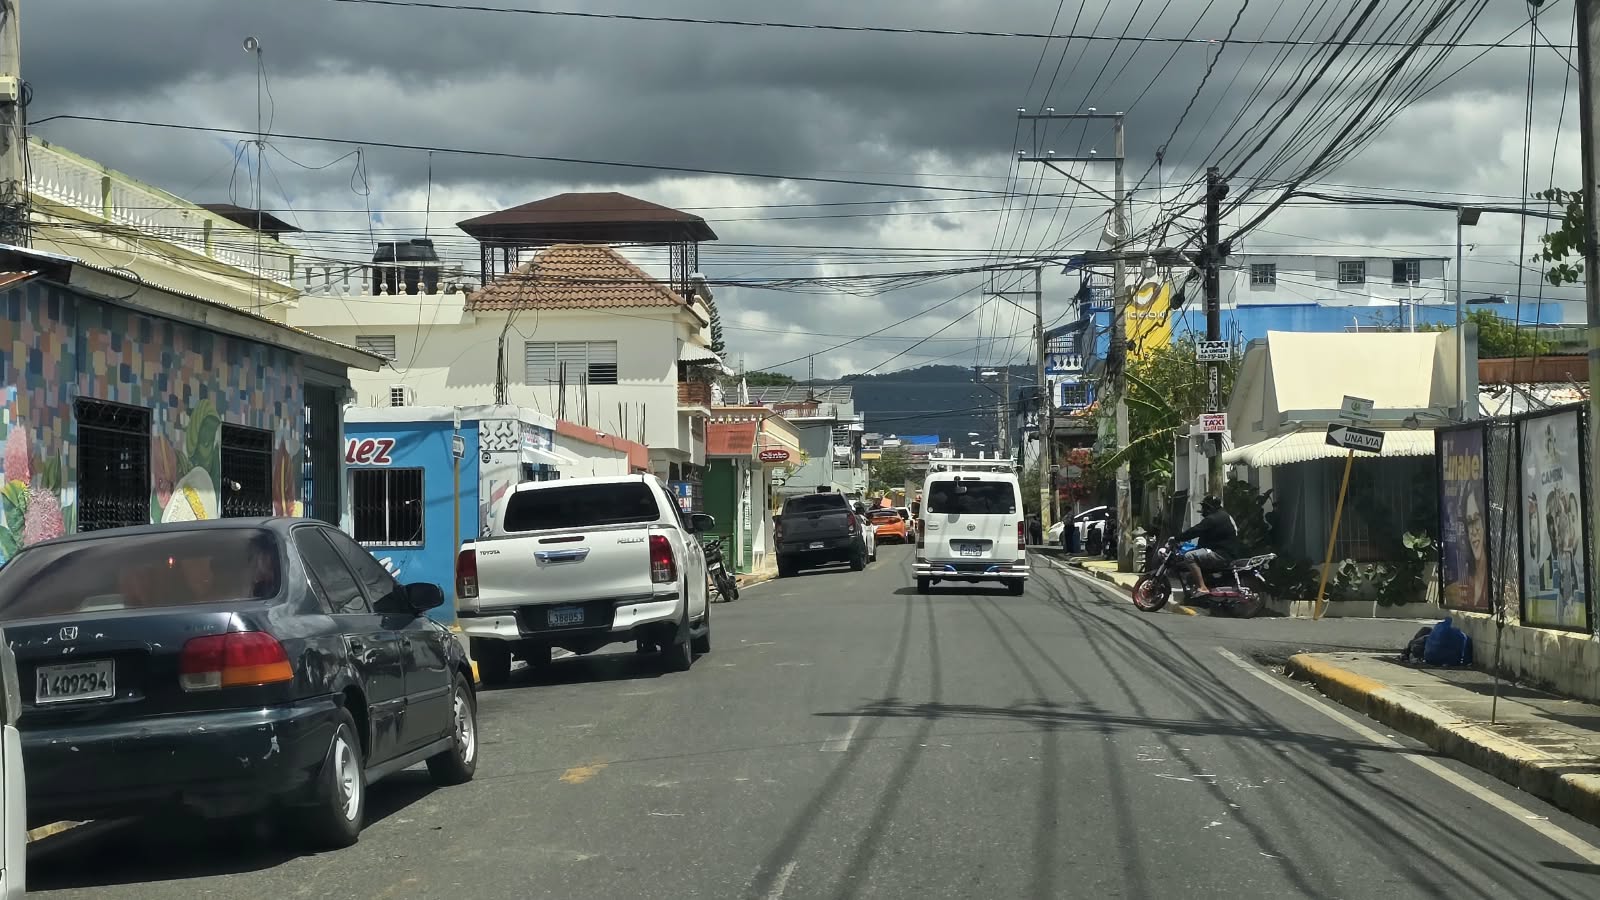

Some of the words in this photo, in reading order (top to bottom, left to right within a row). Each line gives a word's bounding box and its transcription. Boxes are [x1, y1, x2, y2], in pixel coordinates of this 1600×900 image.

[1198, 341, 1229, 349] TAXI
[1344, 432, 1363, 443] UNA
[1365, 436, 1380, 448] VIA
[617, 536, 645, 544] HILUX
